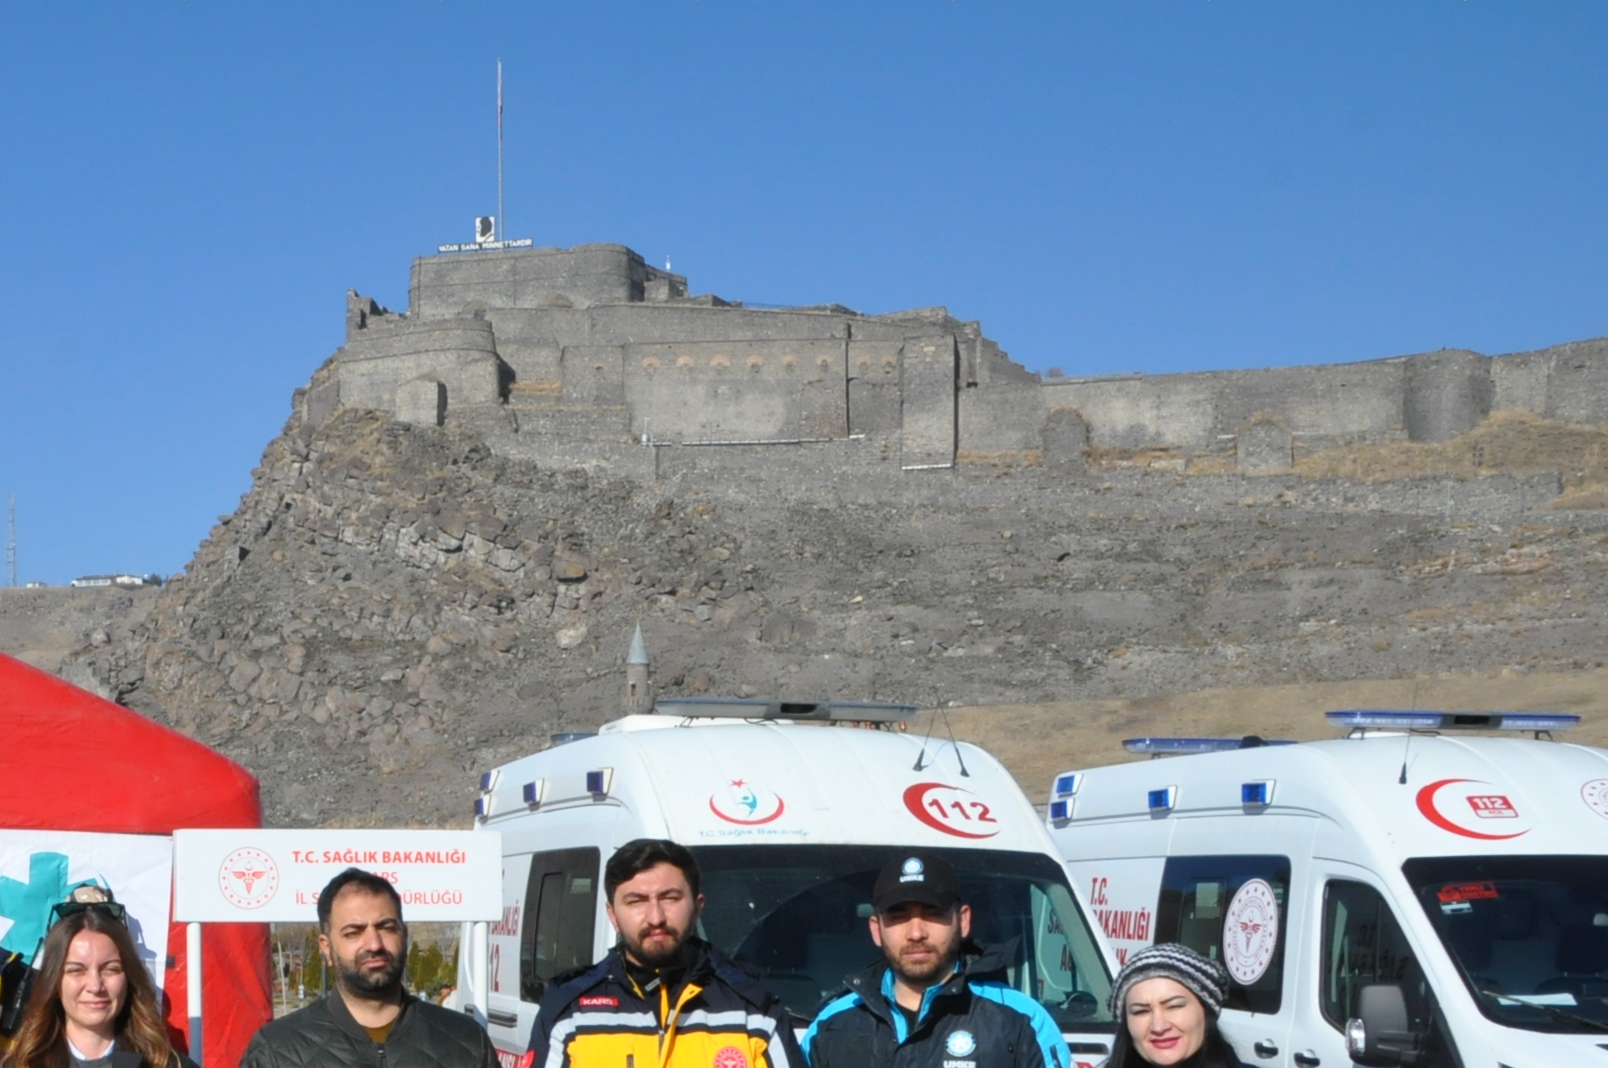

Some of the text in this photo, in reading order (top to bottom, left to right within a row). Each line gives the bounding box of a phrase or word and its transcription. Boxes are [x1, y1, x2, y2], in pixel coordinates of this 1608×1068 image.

[438, 244, 459, 252] VATAN
[927, 799, 998, 823] 112
[1472, 797, 1509, 809] 112
[292, 848, 466, 864] T.C. SAĞLIK BAKANLIĞI
[296, 889, 308, 905] İL
[400, 889, 462, 905] ÜRLÜĞÜ
[1090, 877, 1108, 905] T.C.
[1093, 907, 1151, 941] AKANLIĞI
[583, 997, 614, 1006] KARS
